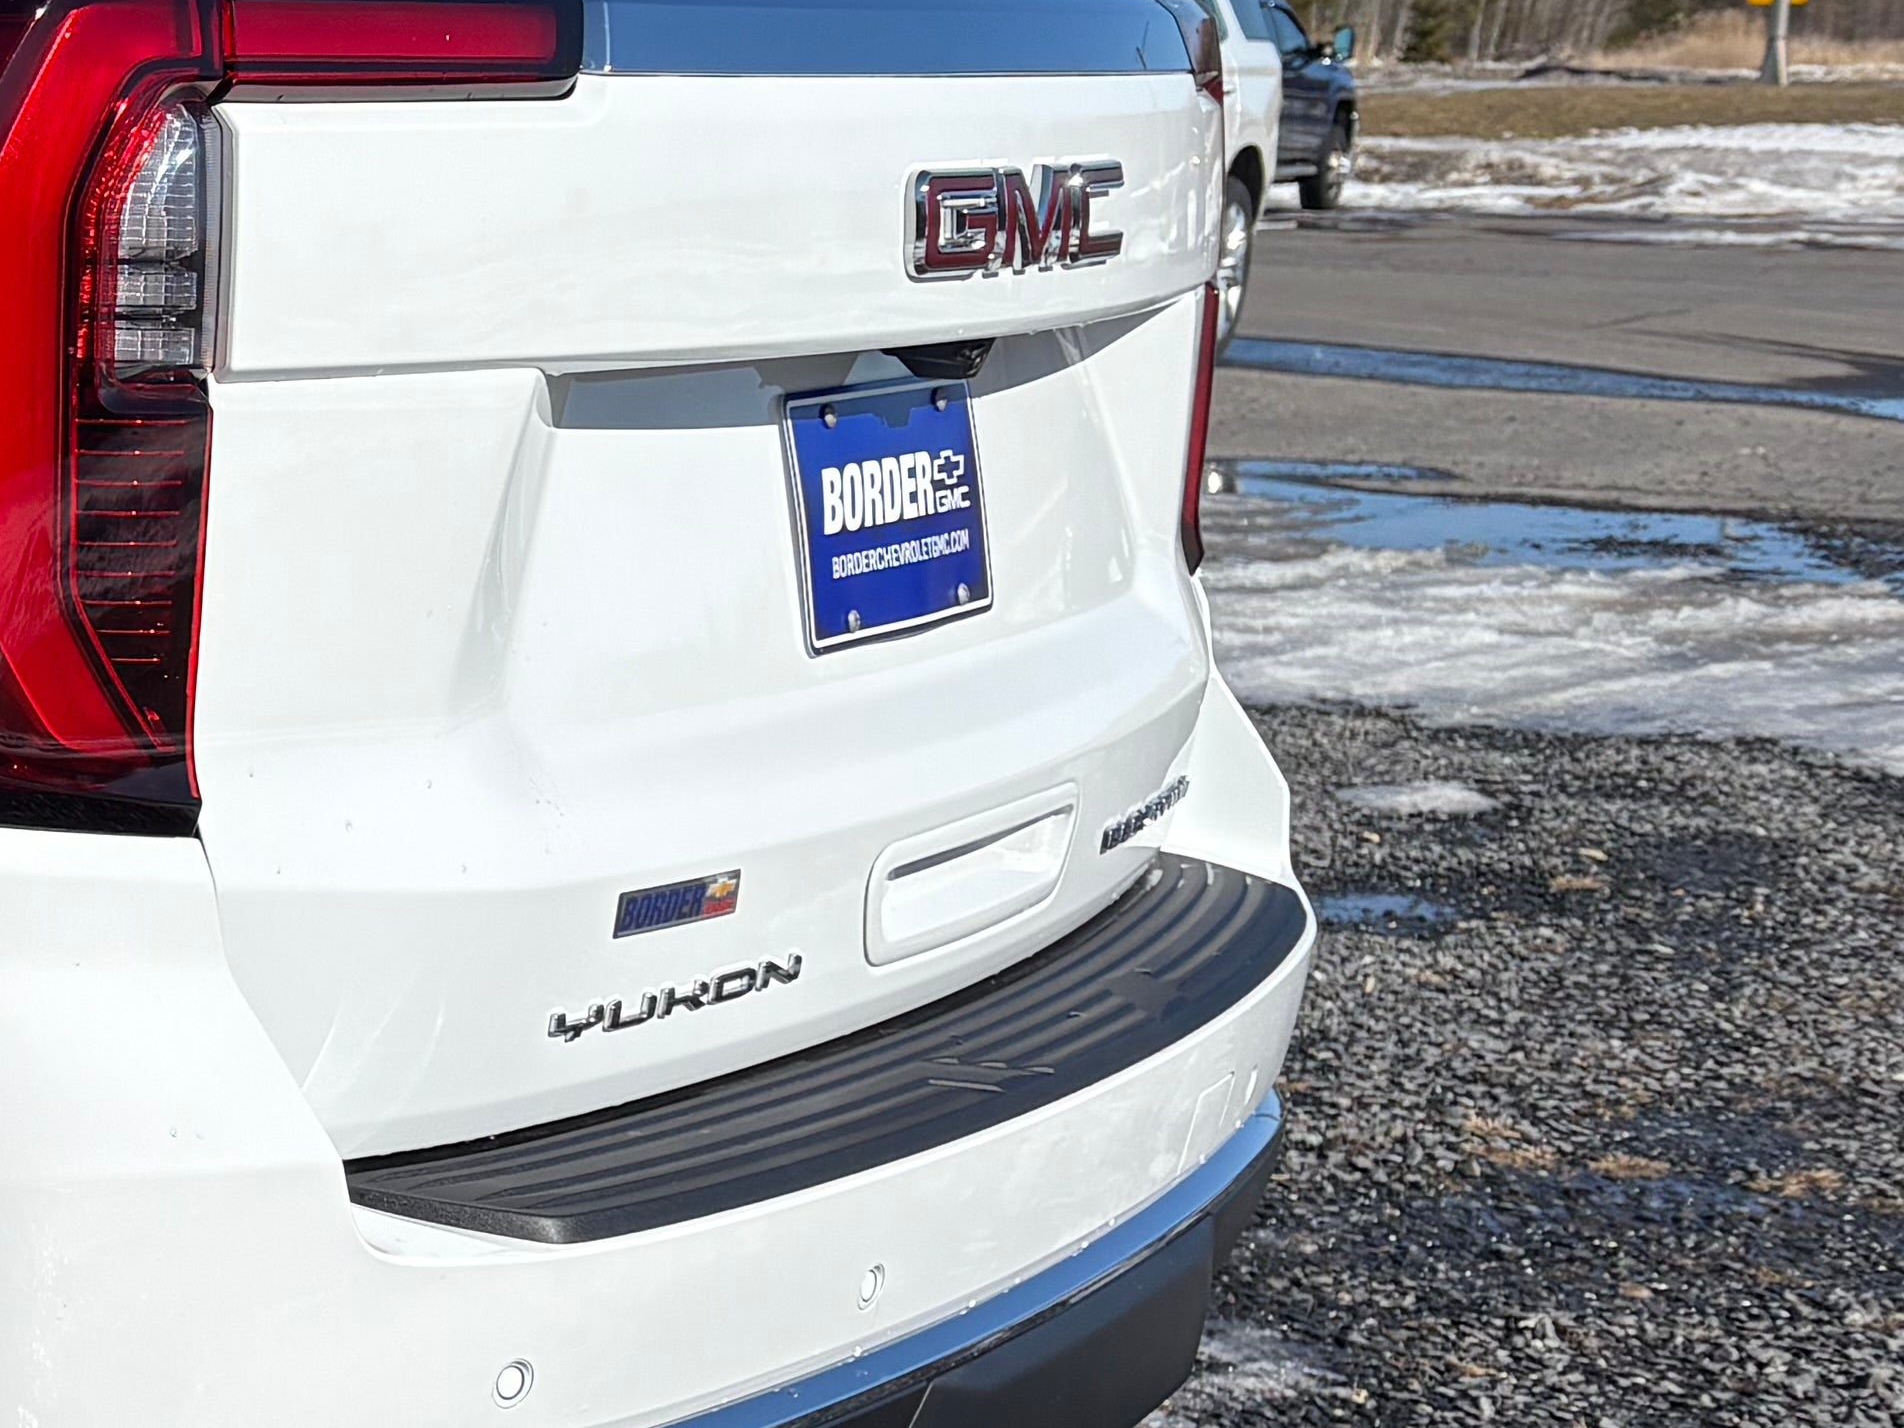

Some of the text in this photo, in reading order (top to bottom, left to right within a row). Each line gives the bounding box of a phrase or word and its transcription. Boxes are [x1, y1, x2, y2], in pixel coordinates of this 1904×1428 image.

[905, 160, 1124, 280] GMC
[821, 450, 935, 536] BORDER
[935, 485, 971, 514] GMC
[832, 529, 970, 580] BORDERCHEVROLETGMC.COM
[618, 882, 707, 933] BORDER
[548, 952, 803, 1043] YUKON
